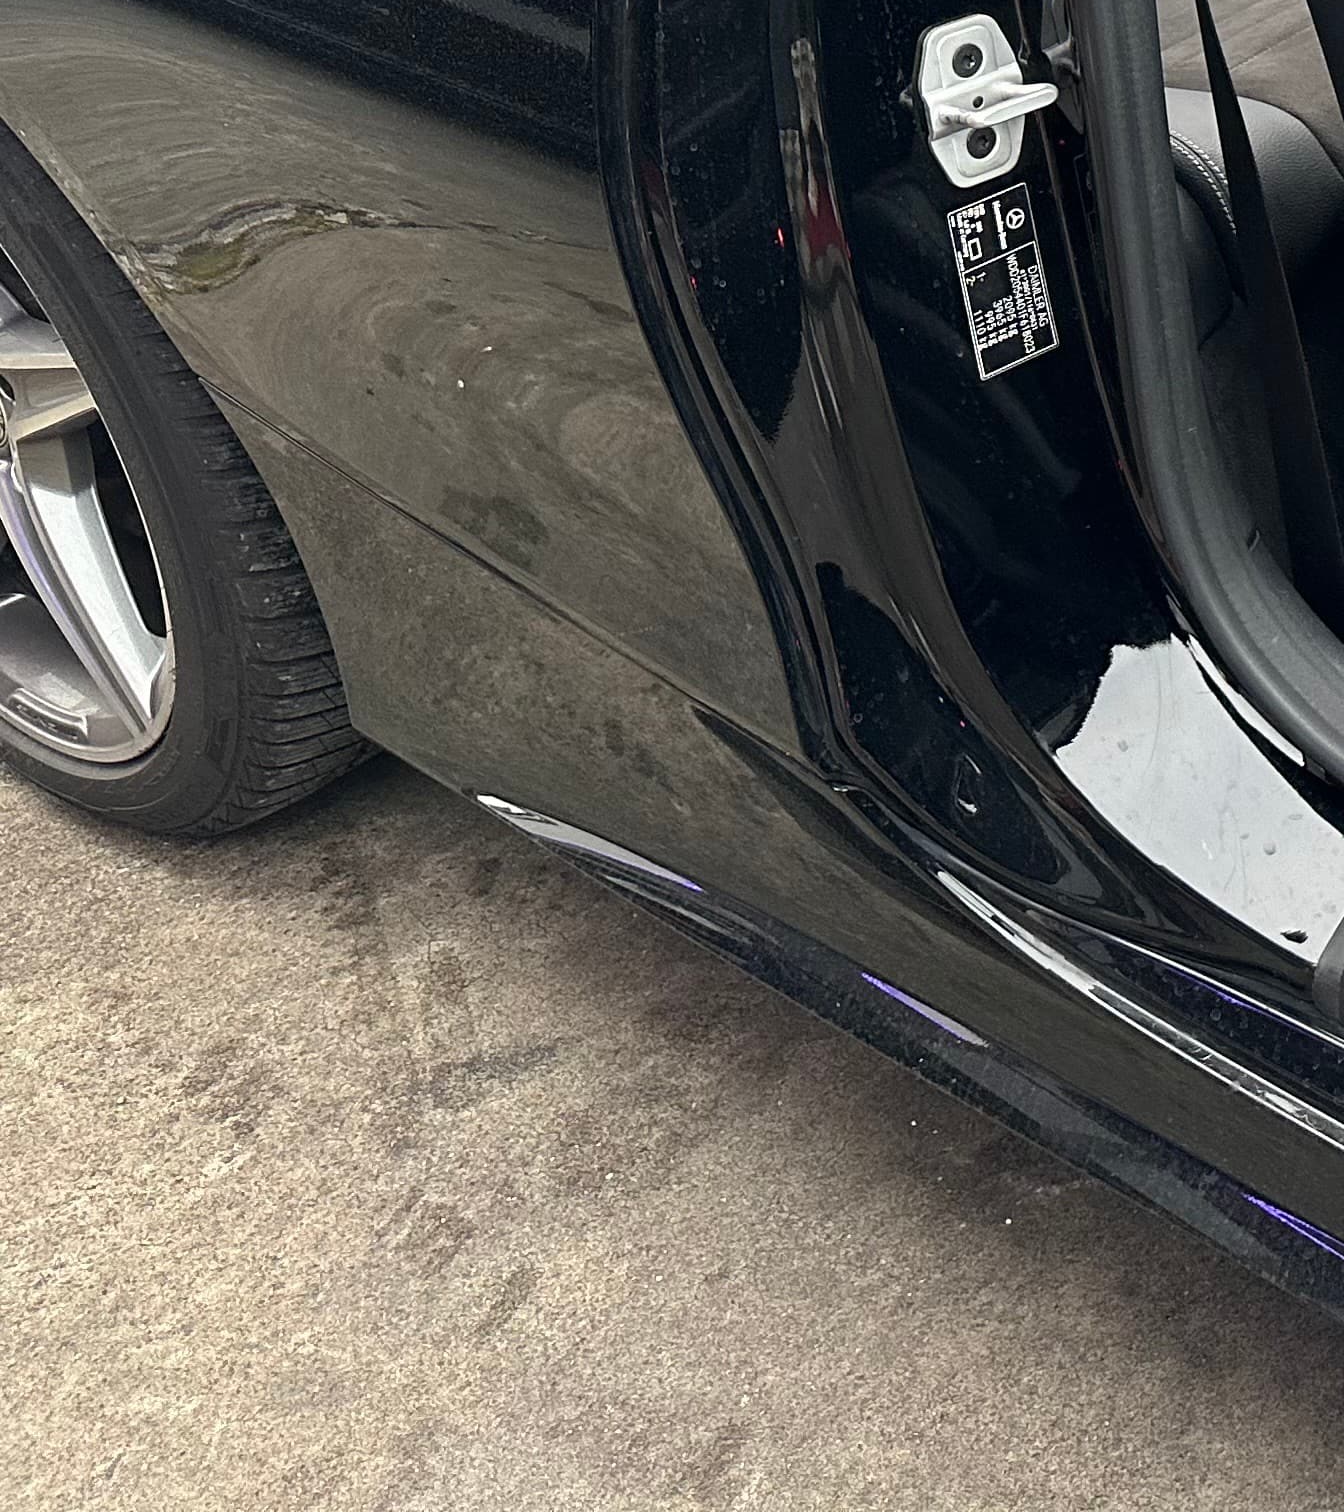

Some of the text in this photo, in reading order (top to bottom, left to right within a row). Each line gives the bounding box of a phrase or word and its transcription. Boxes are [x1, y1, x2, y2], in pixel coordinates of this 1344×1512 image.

[1003, 295, 1017, 321] 2095
[1028, 265, 1048, 327] DAIMLER AG
[974, 310, 986, 335] 1110
[984, 311, 996, 330] 995
[993, 300, 1006, 326] 3965
